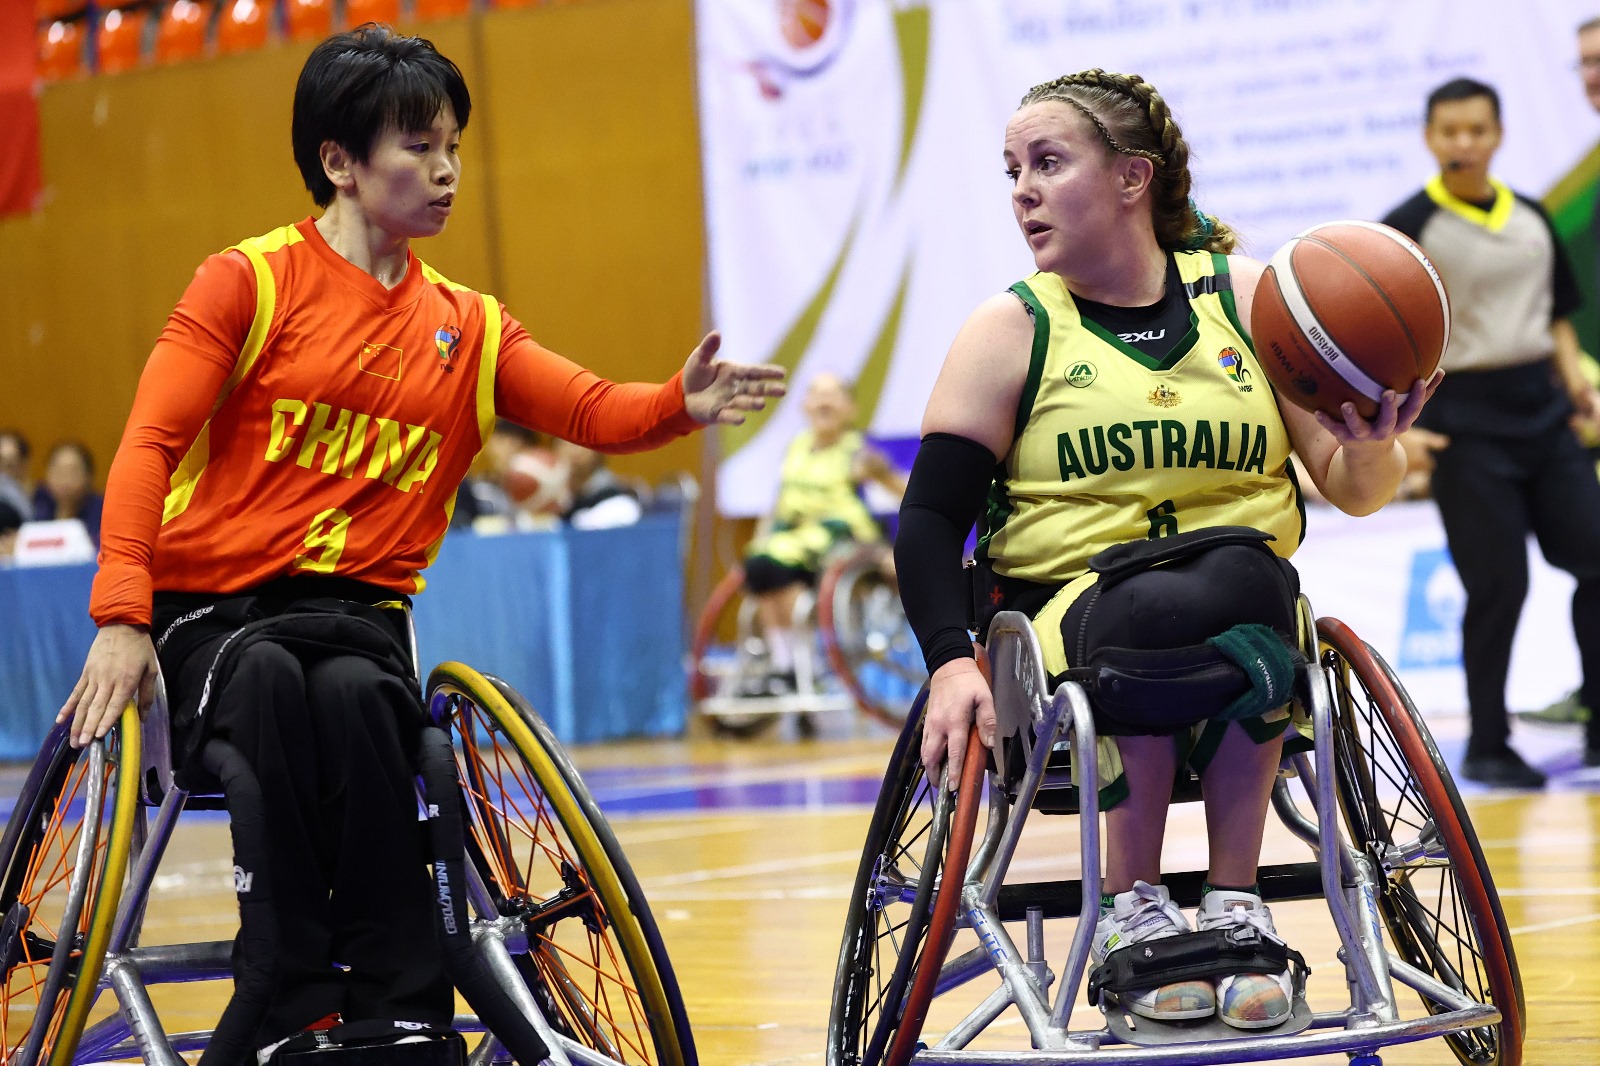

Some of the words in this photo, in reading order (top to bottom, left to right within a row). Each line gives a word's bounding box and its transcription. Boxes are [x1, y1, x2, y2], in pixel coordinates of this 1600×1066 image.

[1116, 328, 1166, 343] 2XU
[1308, 326, 1340, 362] BG4500
[264, 398, 443, 494] CHINA
[1056, 419, 1268, 483] AUSTRALIA
[293, 507, 353, 574] 9
